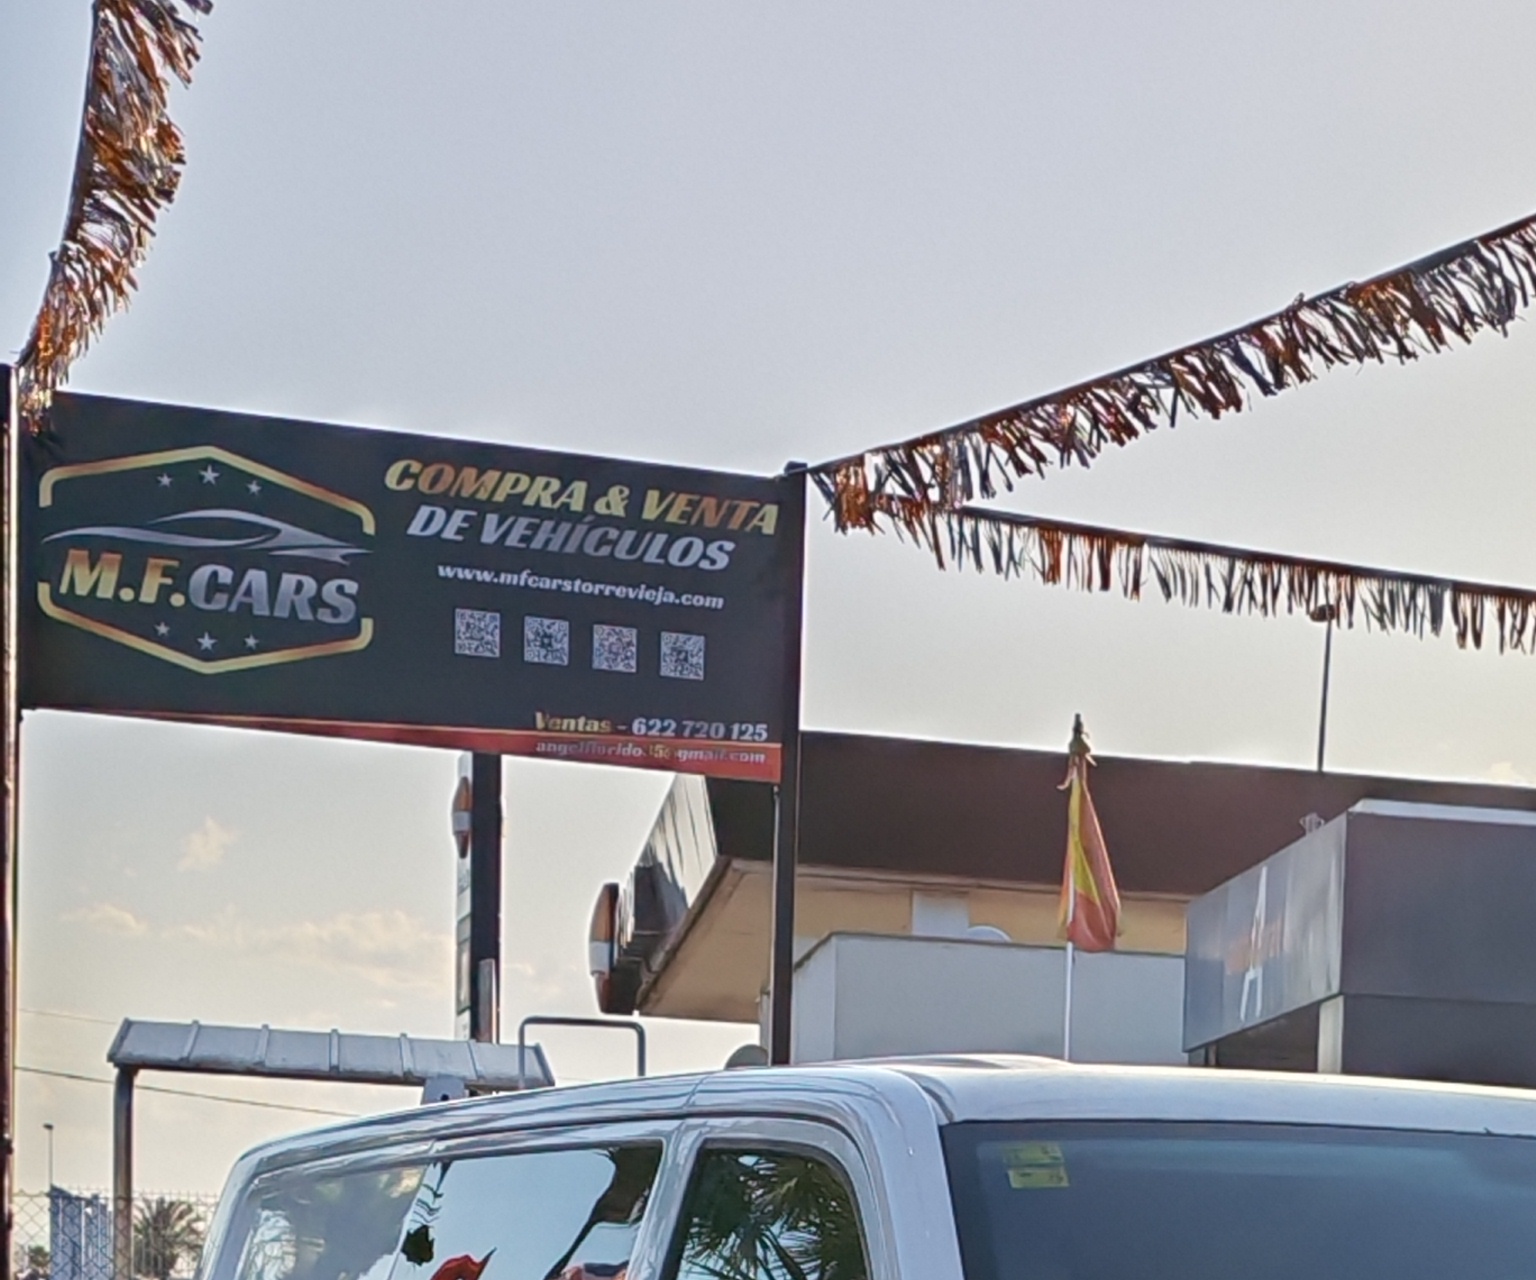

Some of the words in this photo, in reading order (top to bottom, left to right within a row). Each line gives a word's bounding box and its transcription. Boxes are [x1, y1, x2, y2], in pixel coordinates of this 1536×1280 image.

[384, 458, 588, 512] COMPRA
[594, 484, 631, 518] &
[640, 488, 780, 536] VENTA
[406, 504, 479, 542] DE
[480, 511, 736, 572] VEHÍCULOS
[437, 564, 725, 610] www.mfcarstorrevieja.com
[535, 710, 612, 733] Ventas
[632, 717, 676, 737] 622
[682, 720, 725, 738] 720
[730, 722, 769, 742] 125
